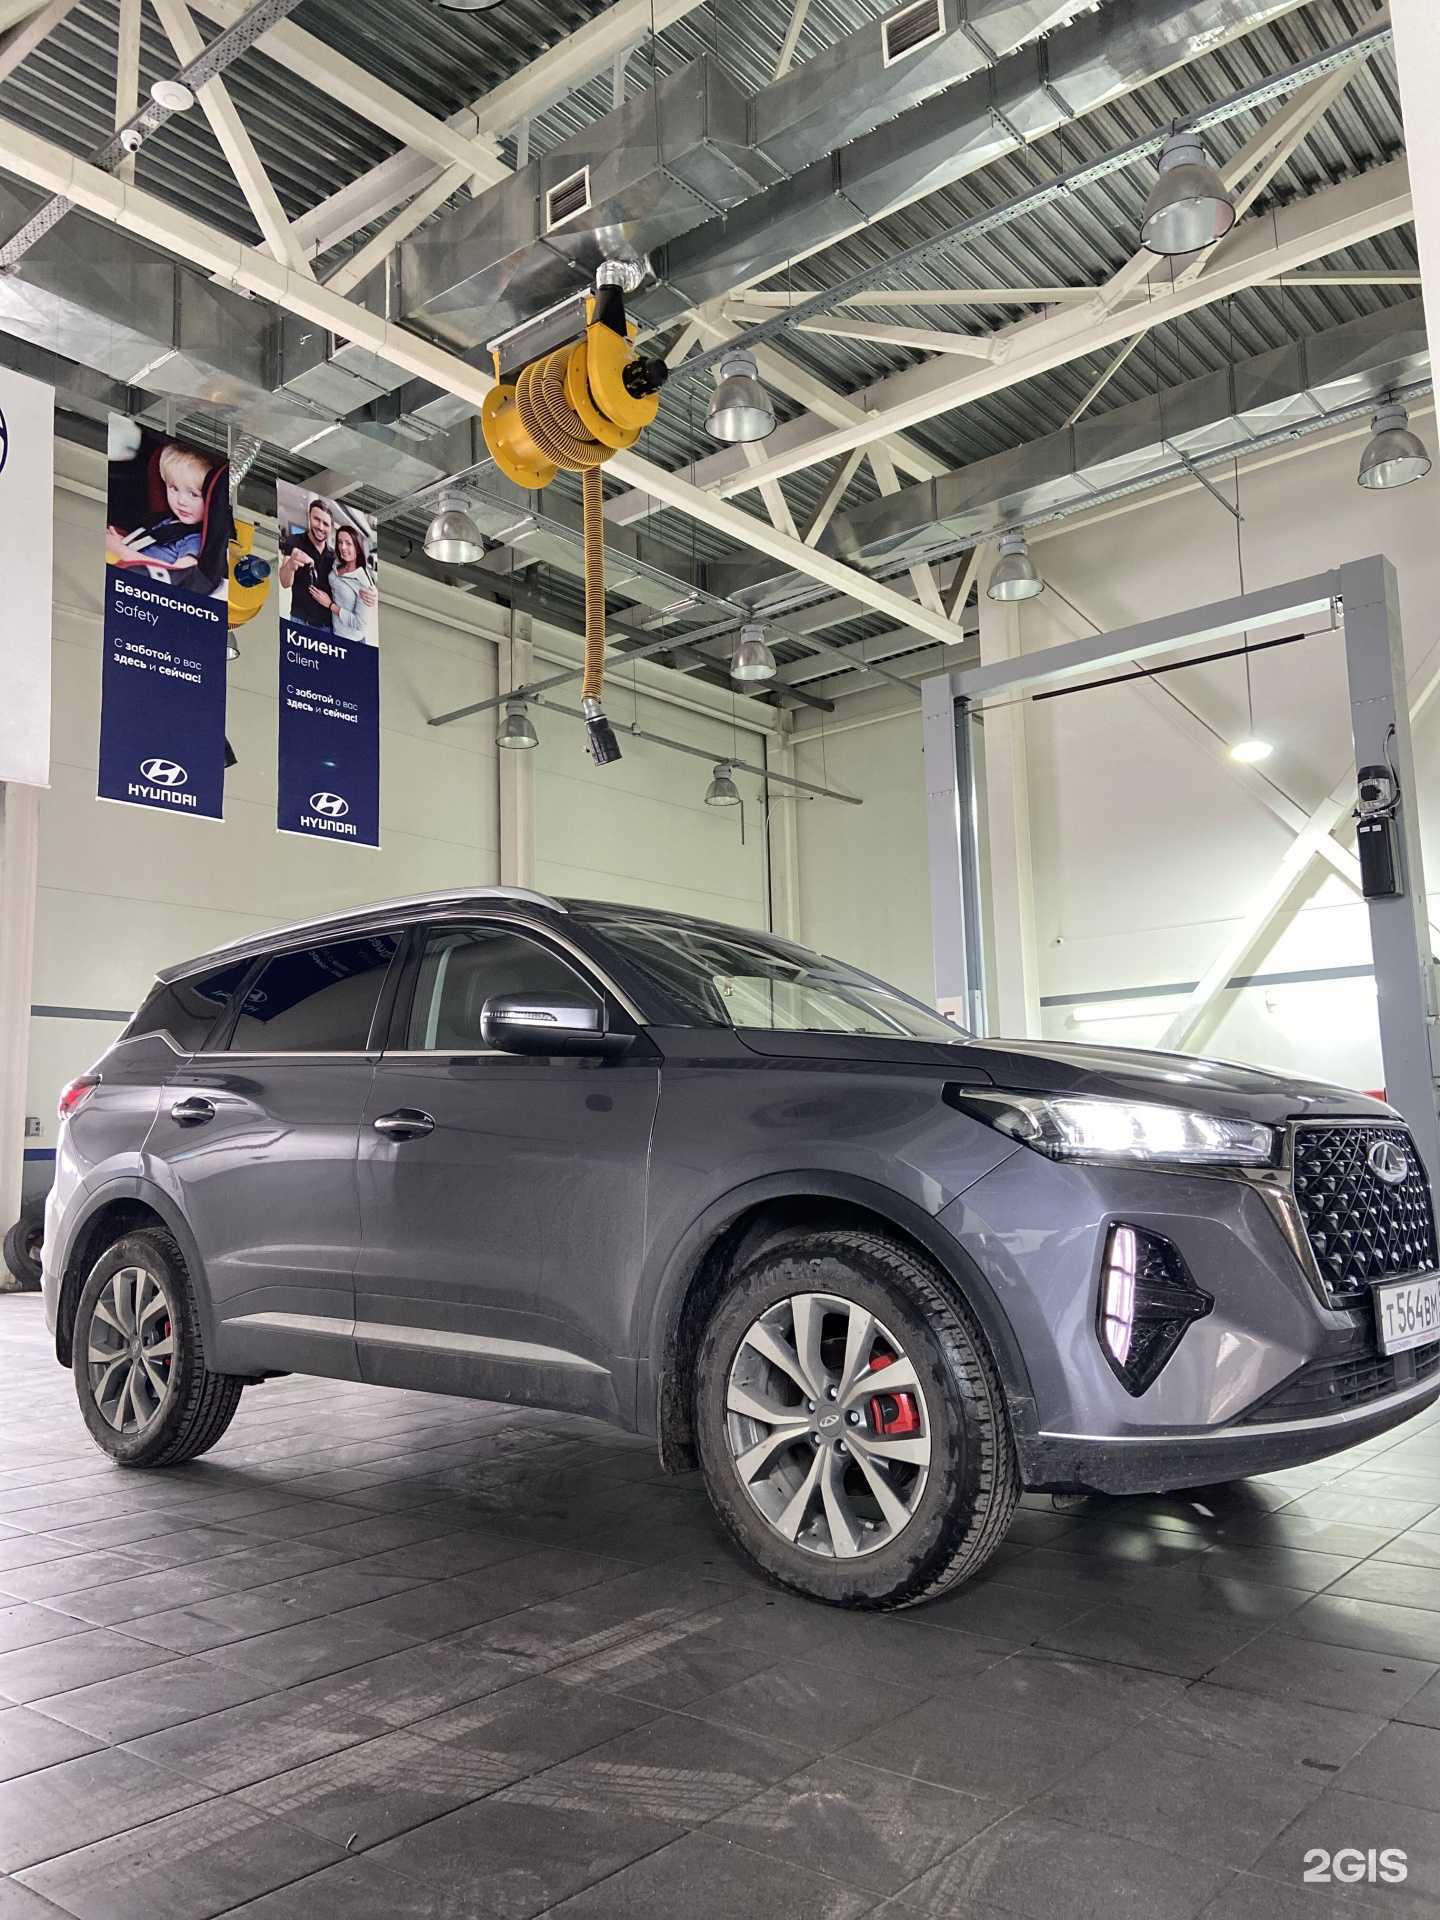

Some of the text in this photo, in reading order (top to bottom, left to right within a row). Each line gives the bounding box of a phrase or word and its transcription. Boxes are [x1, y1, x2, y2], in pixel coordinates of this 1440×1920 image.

[115, 579, 219, 622] Безопасность
[115, 600, 159, 626] Safety
[125, 642, 172, 662] заботой
[174, 657, 181, 665] о
[183, 659, 202, 670] вас
[287, 628, 347, 659] Клиент
[113, 653, 202, 684] здесь и сейчас!
[286, 650, 320, 670] Client
[286, 698, 314, 712] здесь
[323, 708, 359, 724] сейчас!
[295, 688, 334, 704] заботой
[342, 701, 358, 711] вас
[128, 783, 197, 807] HYUNDAI
[300, 815, 357, 836] HYUNDAI
